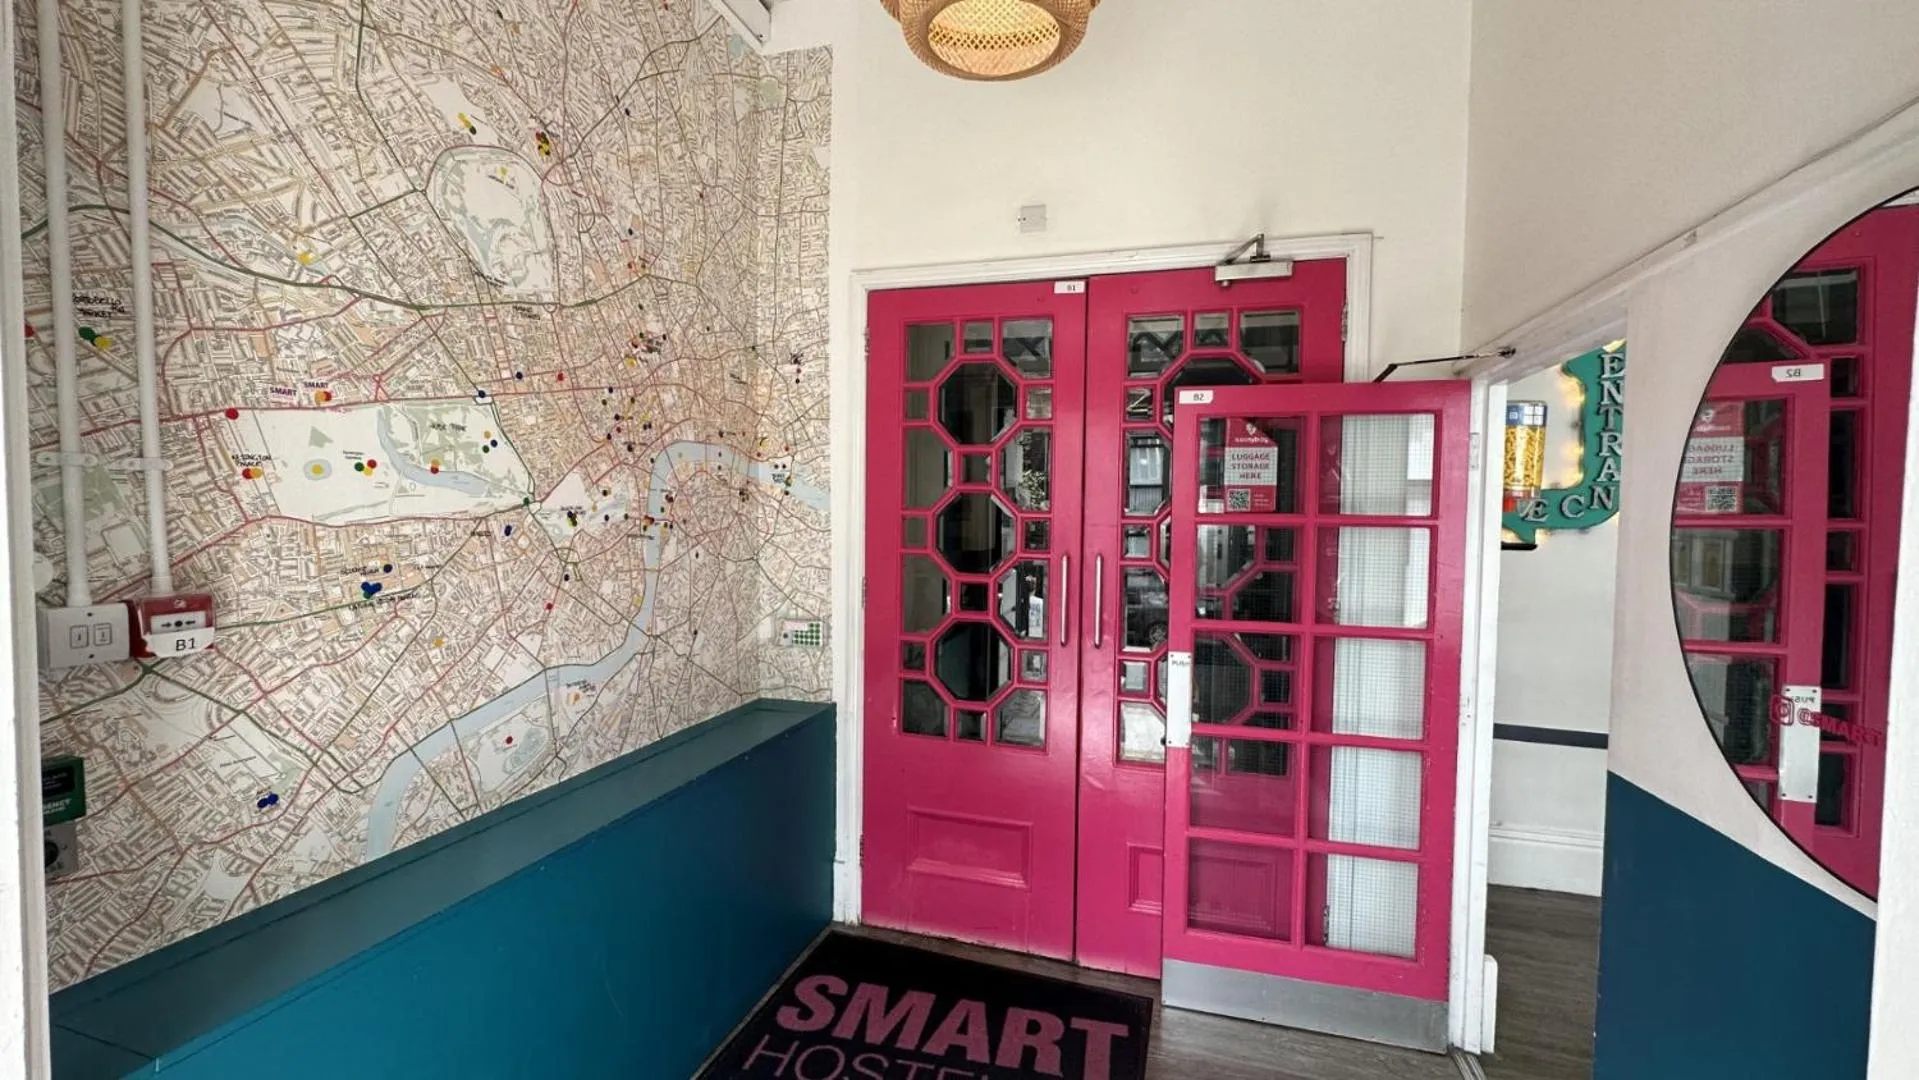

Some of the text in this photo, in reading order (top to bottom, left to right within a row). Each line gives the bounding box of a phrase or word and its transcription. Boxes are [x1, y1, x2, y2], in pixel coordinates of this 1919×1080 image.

[269, 386, 297, 397] SMART
[1193, 392, 1206, 402] B2
[1231, 452, 1271, 461] LUGGAGE
[1231, 462, 1270, 470] STORAGE
[1239, 472, 1262, 480] HERE
[175, 637, 195, 651] B1
[775, 973, 1129, 1080] SMART
[741, 1034, 988, 1080] HOST
